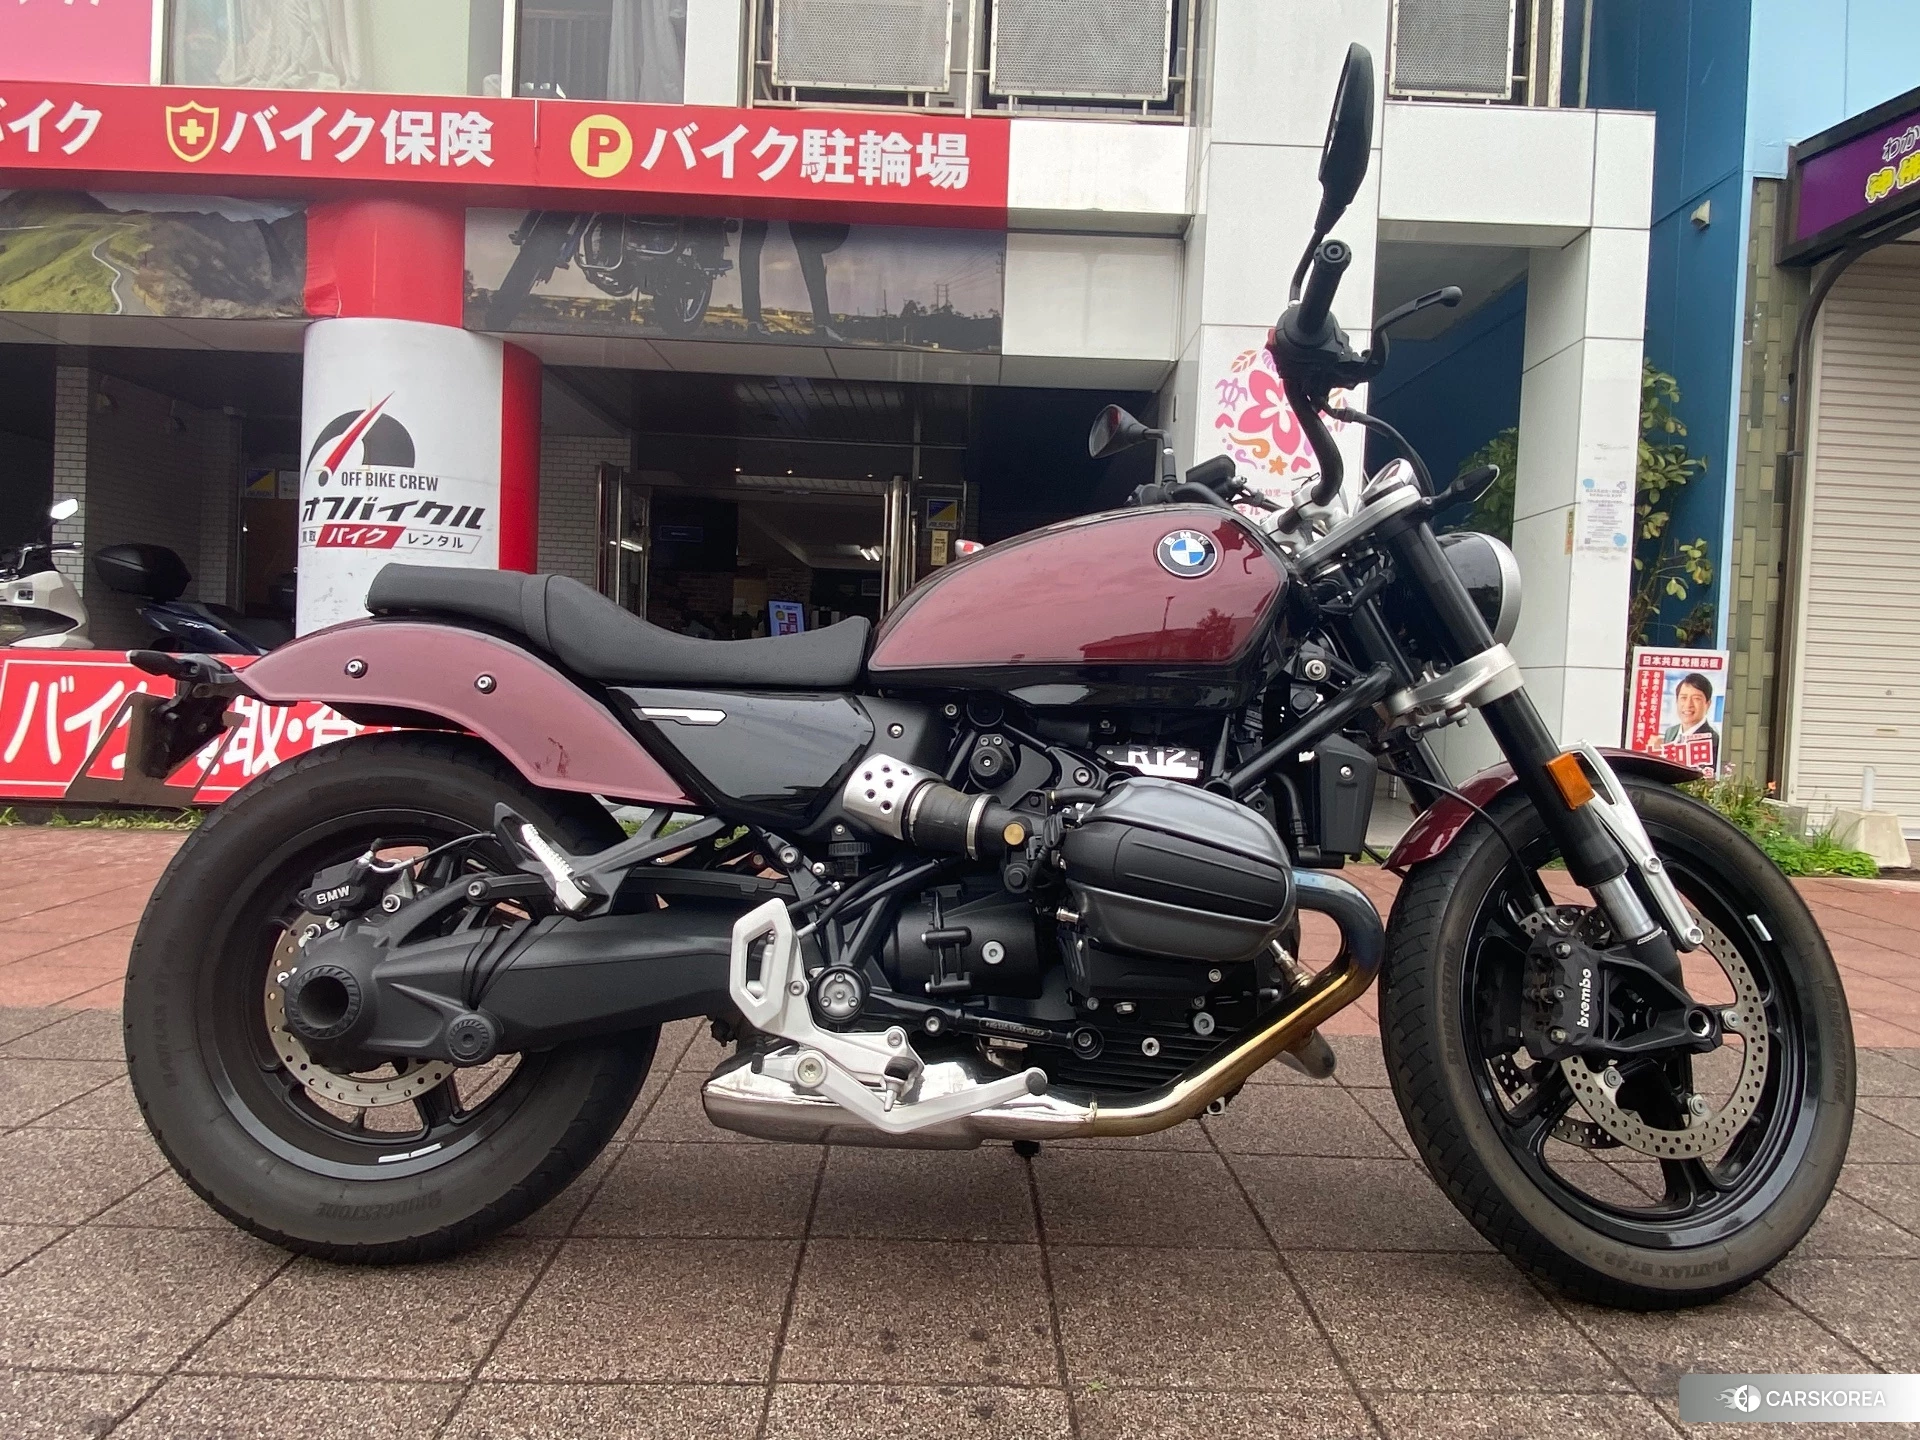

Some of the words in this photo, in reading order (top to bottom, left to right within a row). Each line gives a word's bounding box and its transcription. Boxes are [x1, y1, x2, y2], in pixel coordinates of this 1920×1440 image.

[0, 98, 102, 155] イク
[221, 105, 495, 167] バイク保険
[641, 121, 970, 189] バイク駐輪場
[341, 471, 362, 487] OFF
[365, 472, 396, 488] BIKE
[400, 474, 439, 492] CREW
[302, 496, 486, 530] オフバイクル
[326, 527, 388, 545] バイク
[408, 532, 464, 549] レンタル
[1164, 531, 1209, 546] BMW
[1642, 655, 1720, 668] 日本共産党掲示板
[316, 885, 350, 905] BMW
[1576, 968, 1592, 1028] brembo
